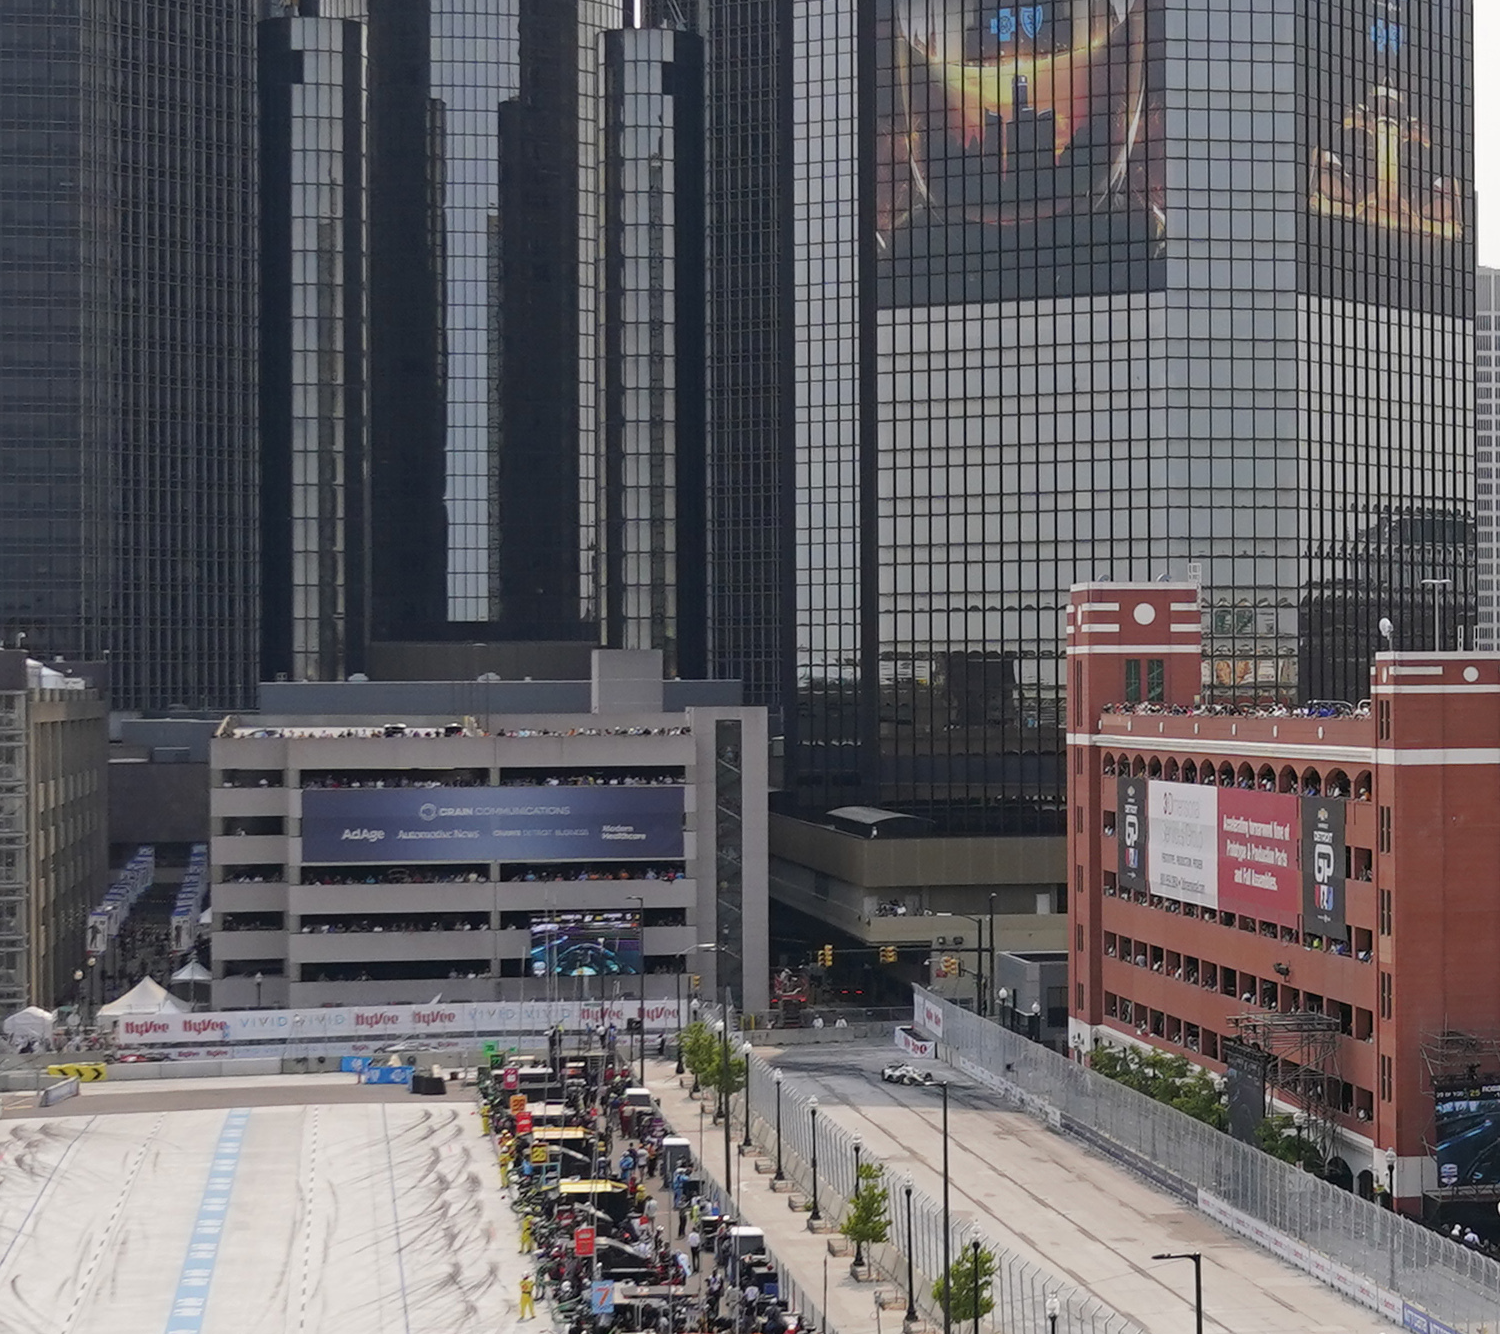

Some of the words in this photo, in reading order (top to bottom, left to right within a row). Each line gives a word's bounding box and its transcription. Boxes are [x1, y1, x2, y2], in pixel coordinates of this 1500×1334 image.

[341, 828, 386, 842] AdAge
[1314, 843, 1334, 884] GP
[597, 1287, 610, 1308] 7
